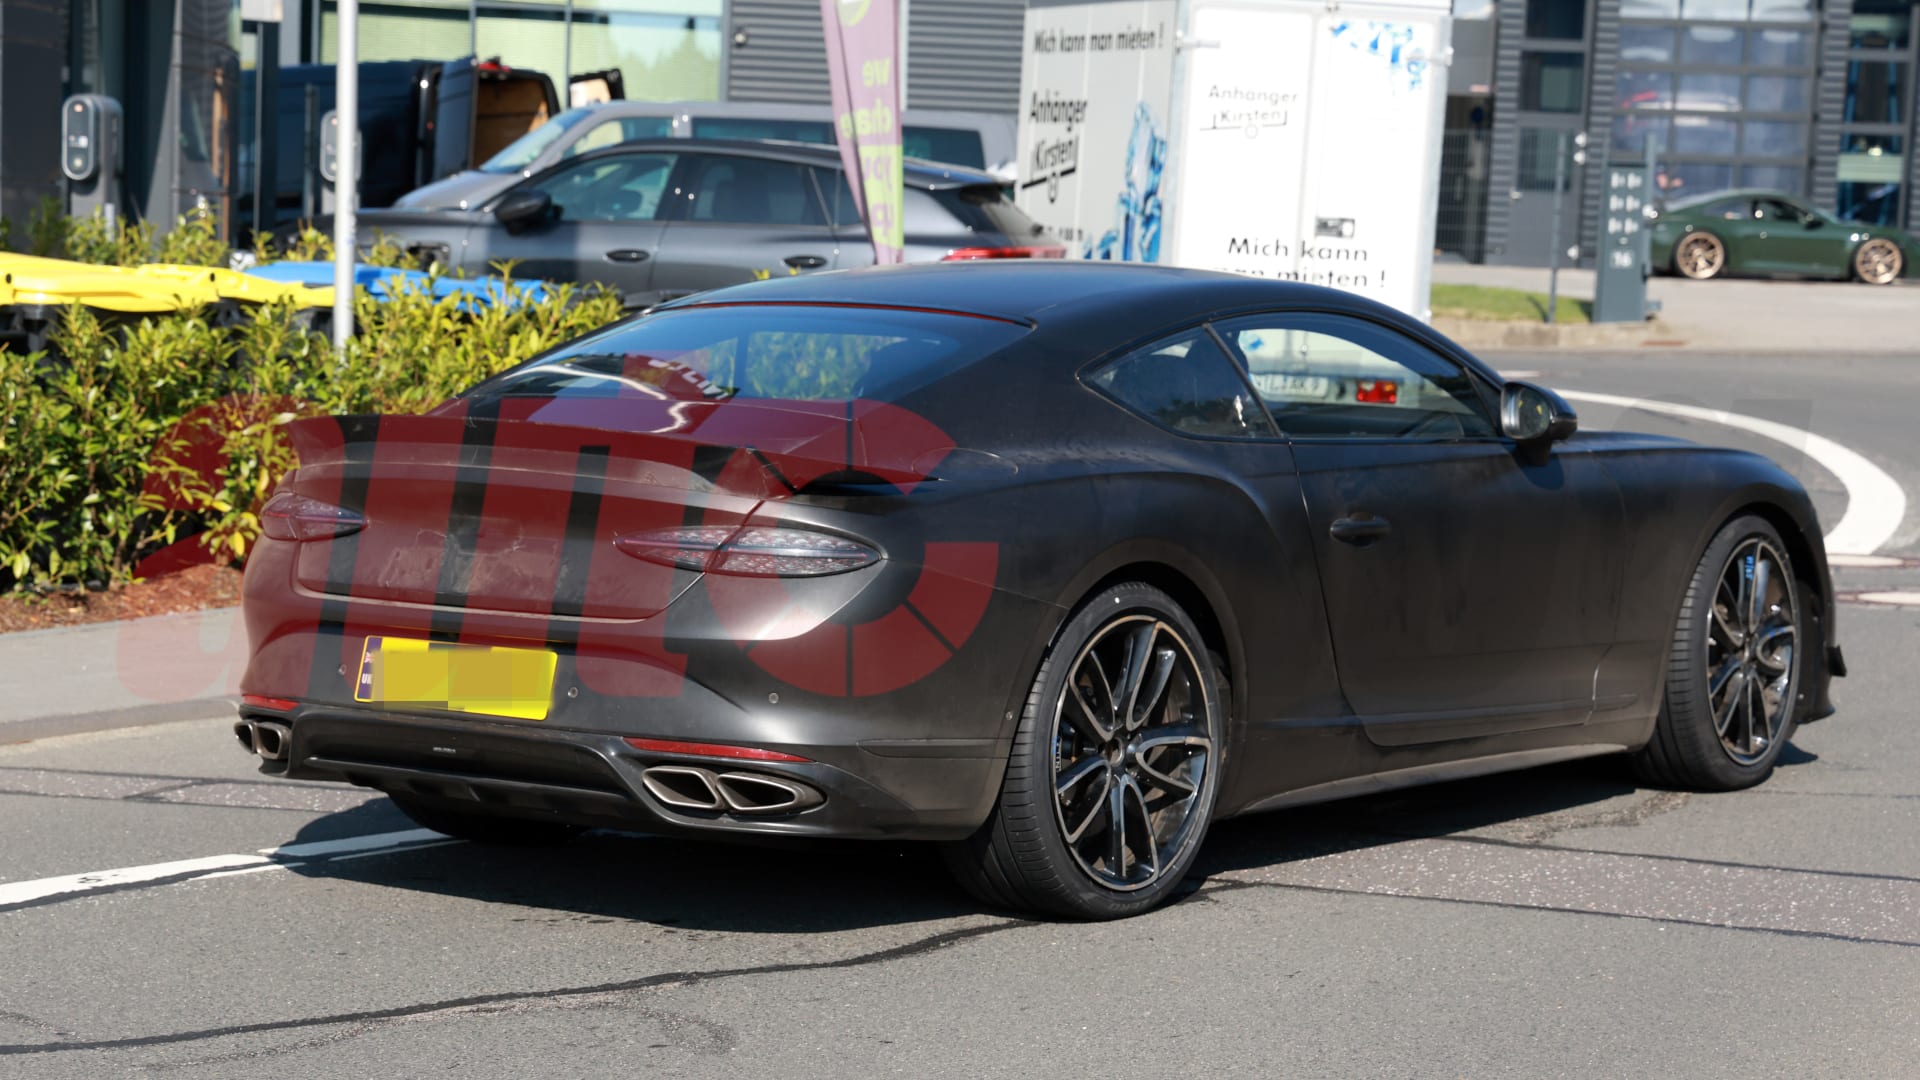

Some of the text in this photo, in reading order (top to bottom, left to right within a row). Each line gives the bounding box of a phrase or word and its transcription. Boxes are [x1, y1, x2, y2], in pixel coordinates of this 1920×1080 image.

[1033, 27, 1056, 53] Mich
[1060, 27, 1086, 52] kann
[1229, 237, 1368, 261] Mich kann
